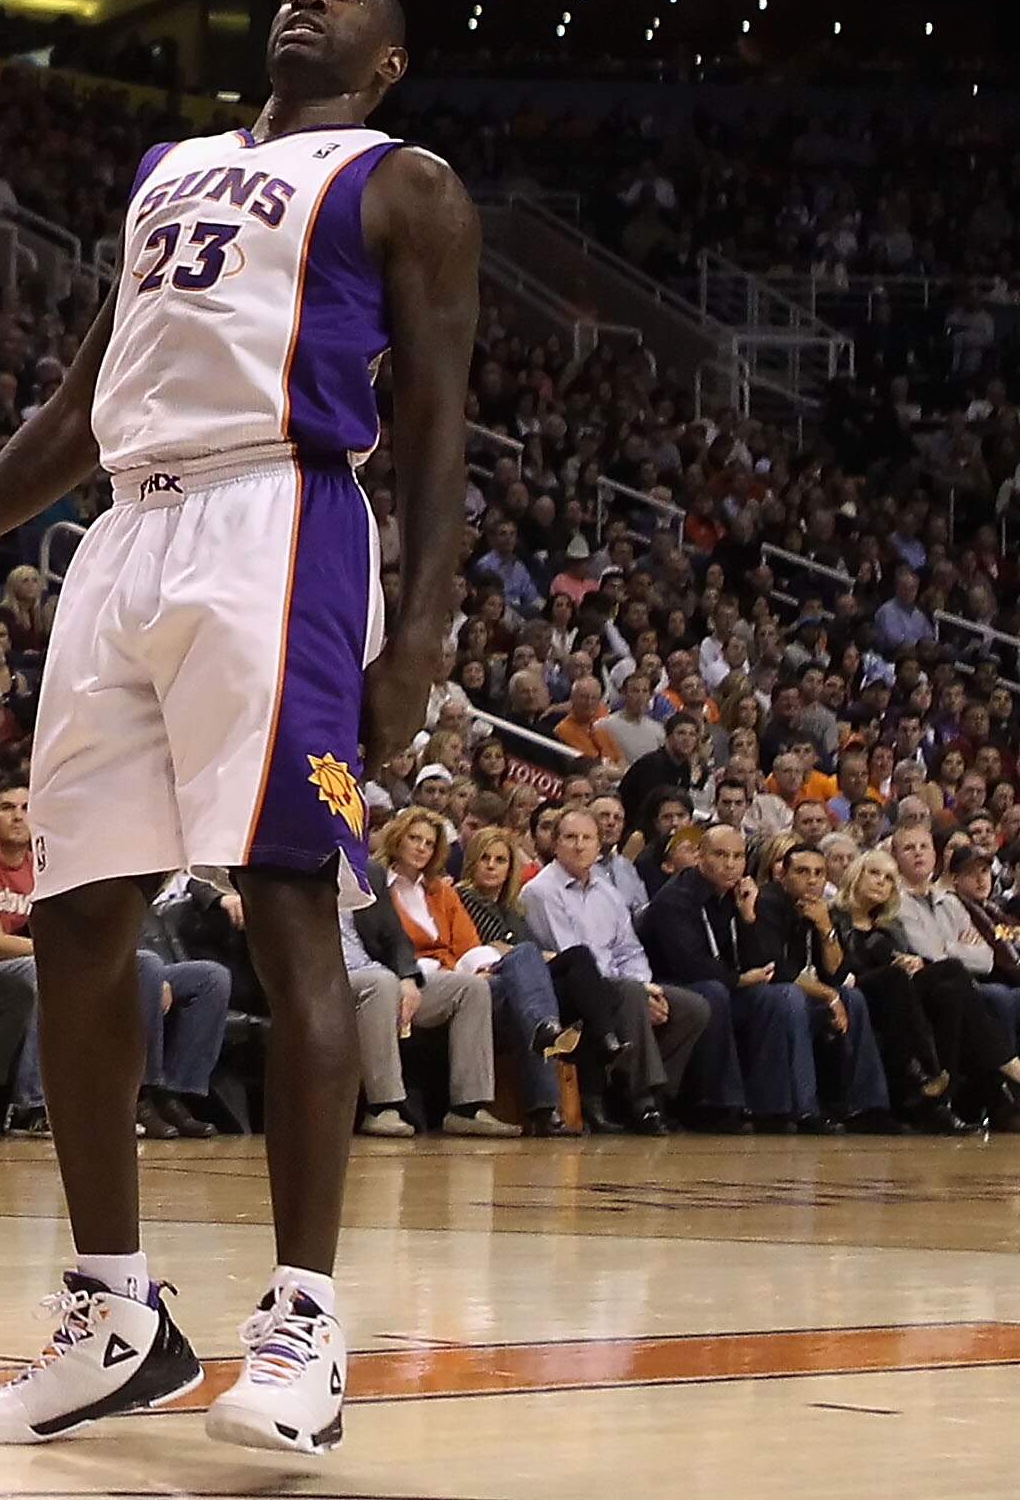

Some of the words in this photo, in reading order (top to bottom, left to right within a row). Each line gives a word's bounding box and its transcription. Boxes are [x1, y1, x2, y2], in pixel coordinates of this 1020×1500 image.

[134, 166, 297, 229] SUNS
[136, 221, 242, 297] 23
[139, 471, 184, 503] PHX
